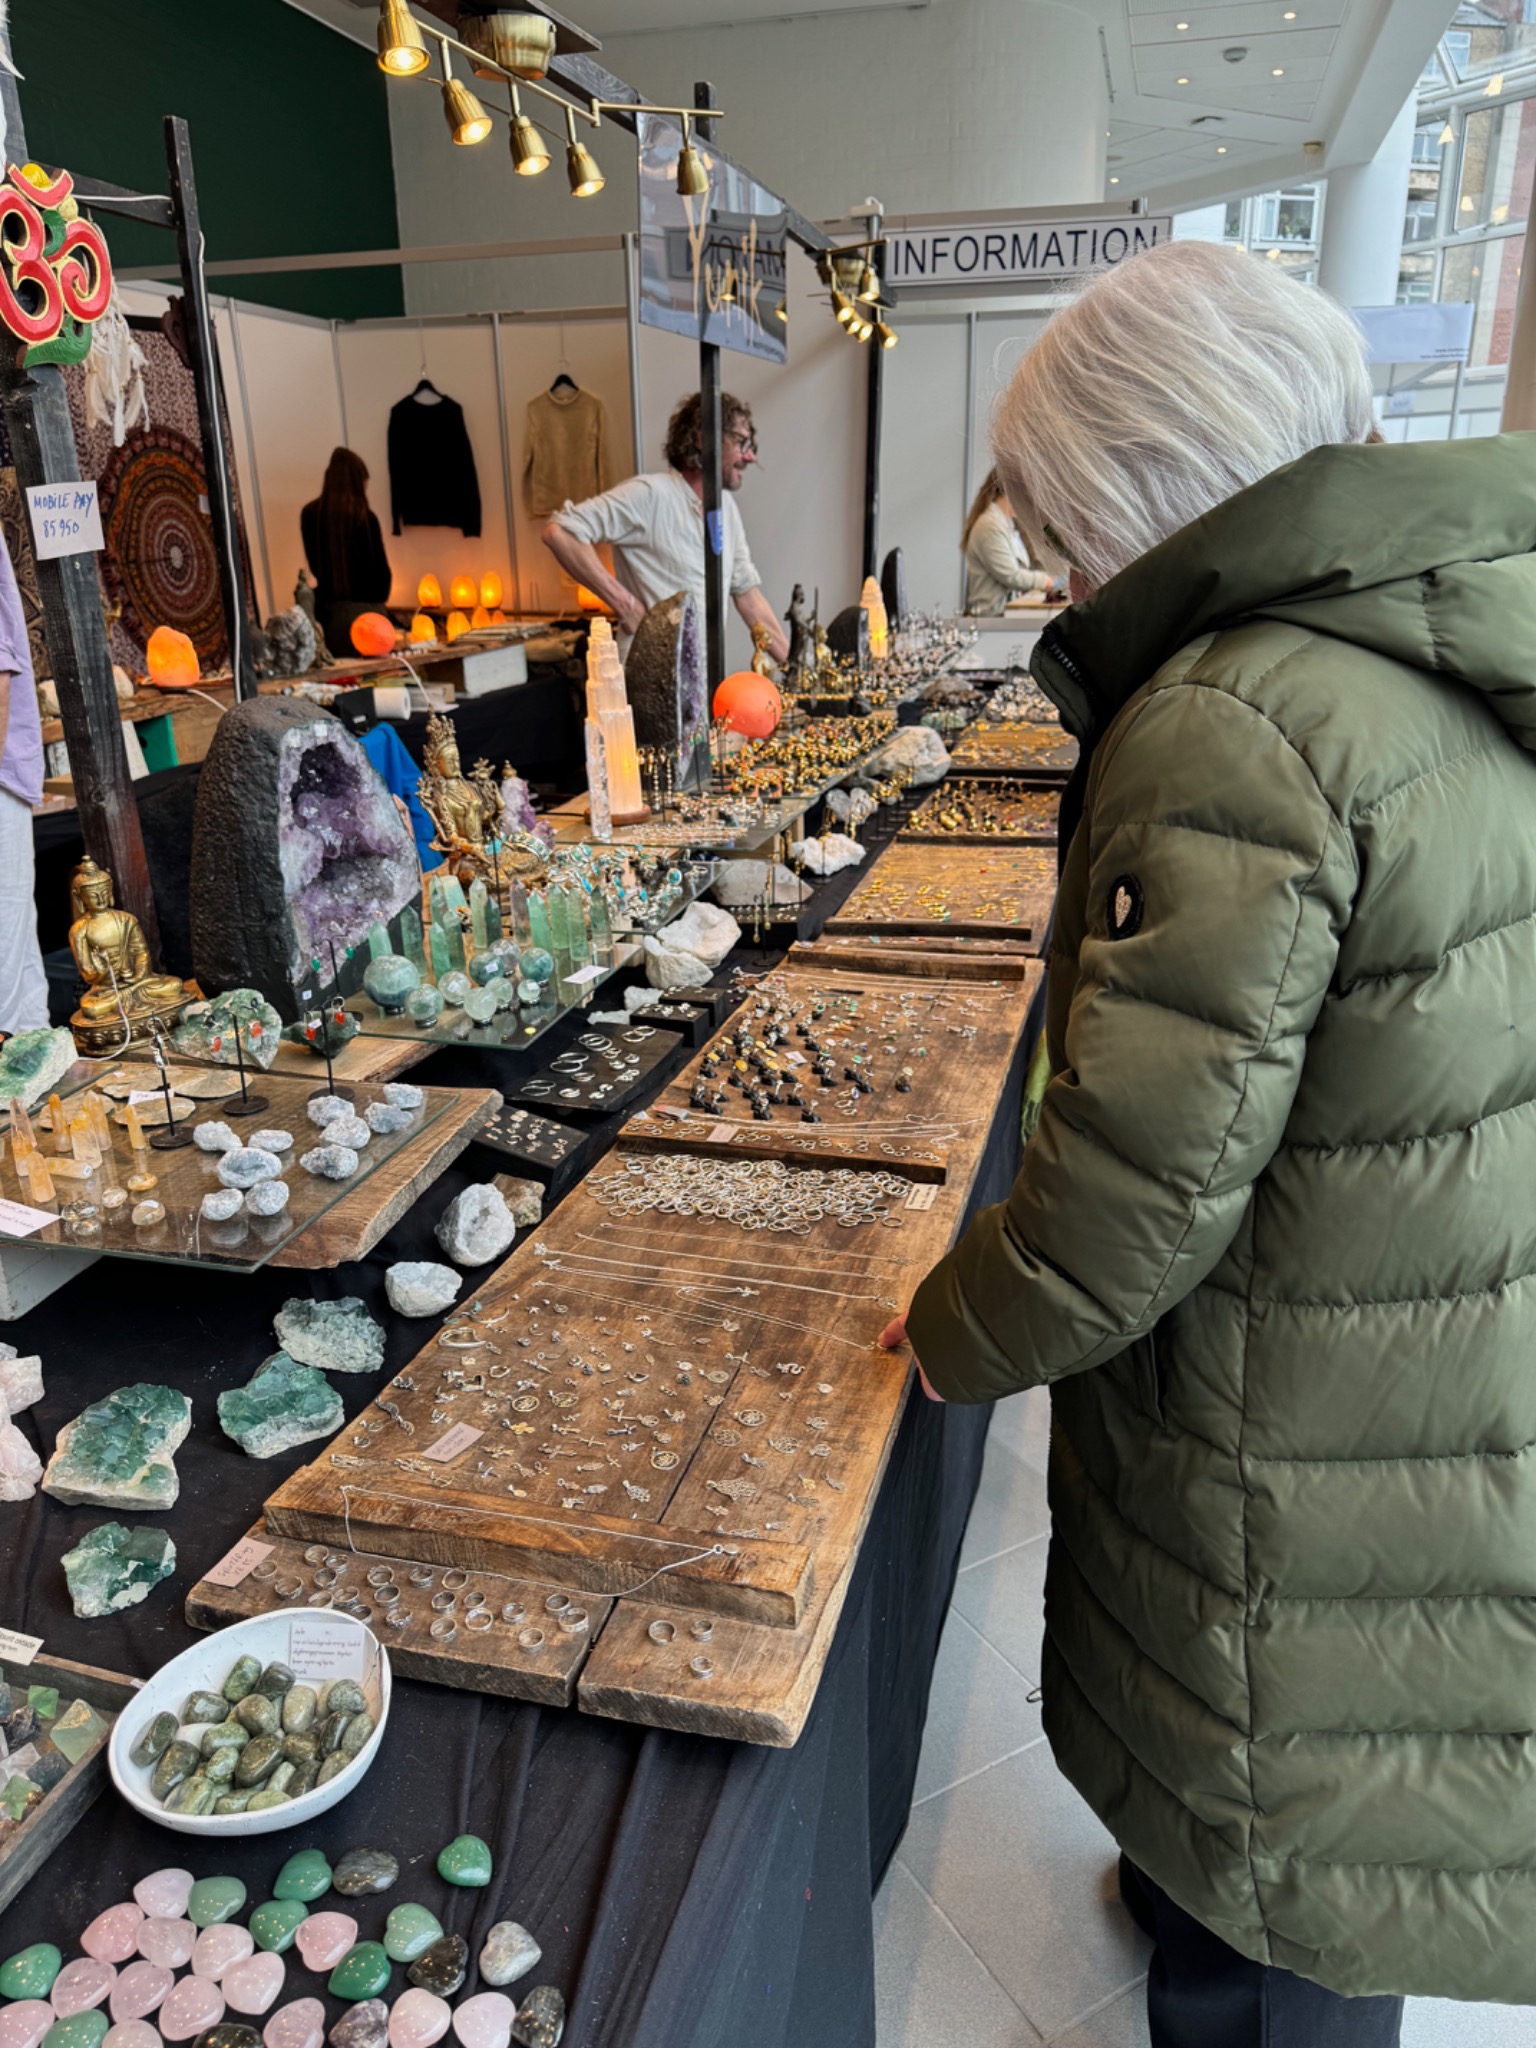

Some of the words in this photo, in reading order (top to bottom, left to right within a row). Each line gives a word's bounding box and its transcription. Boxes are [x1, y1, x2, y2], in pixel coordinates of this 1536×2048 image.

[893, 225, 1157, 276] INFORMATION
[73, 491, 94, 518] PAY
[43, 520, 57, 538] 85
[59, 518, 80, 538] 950
